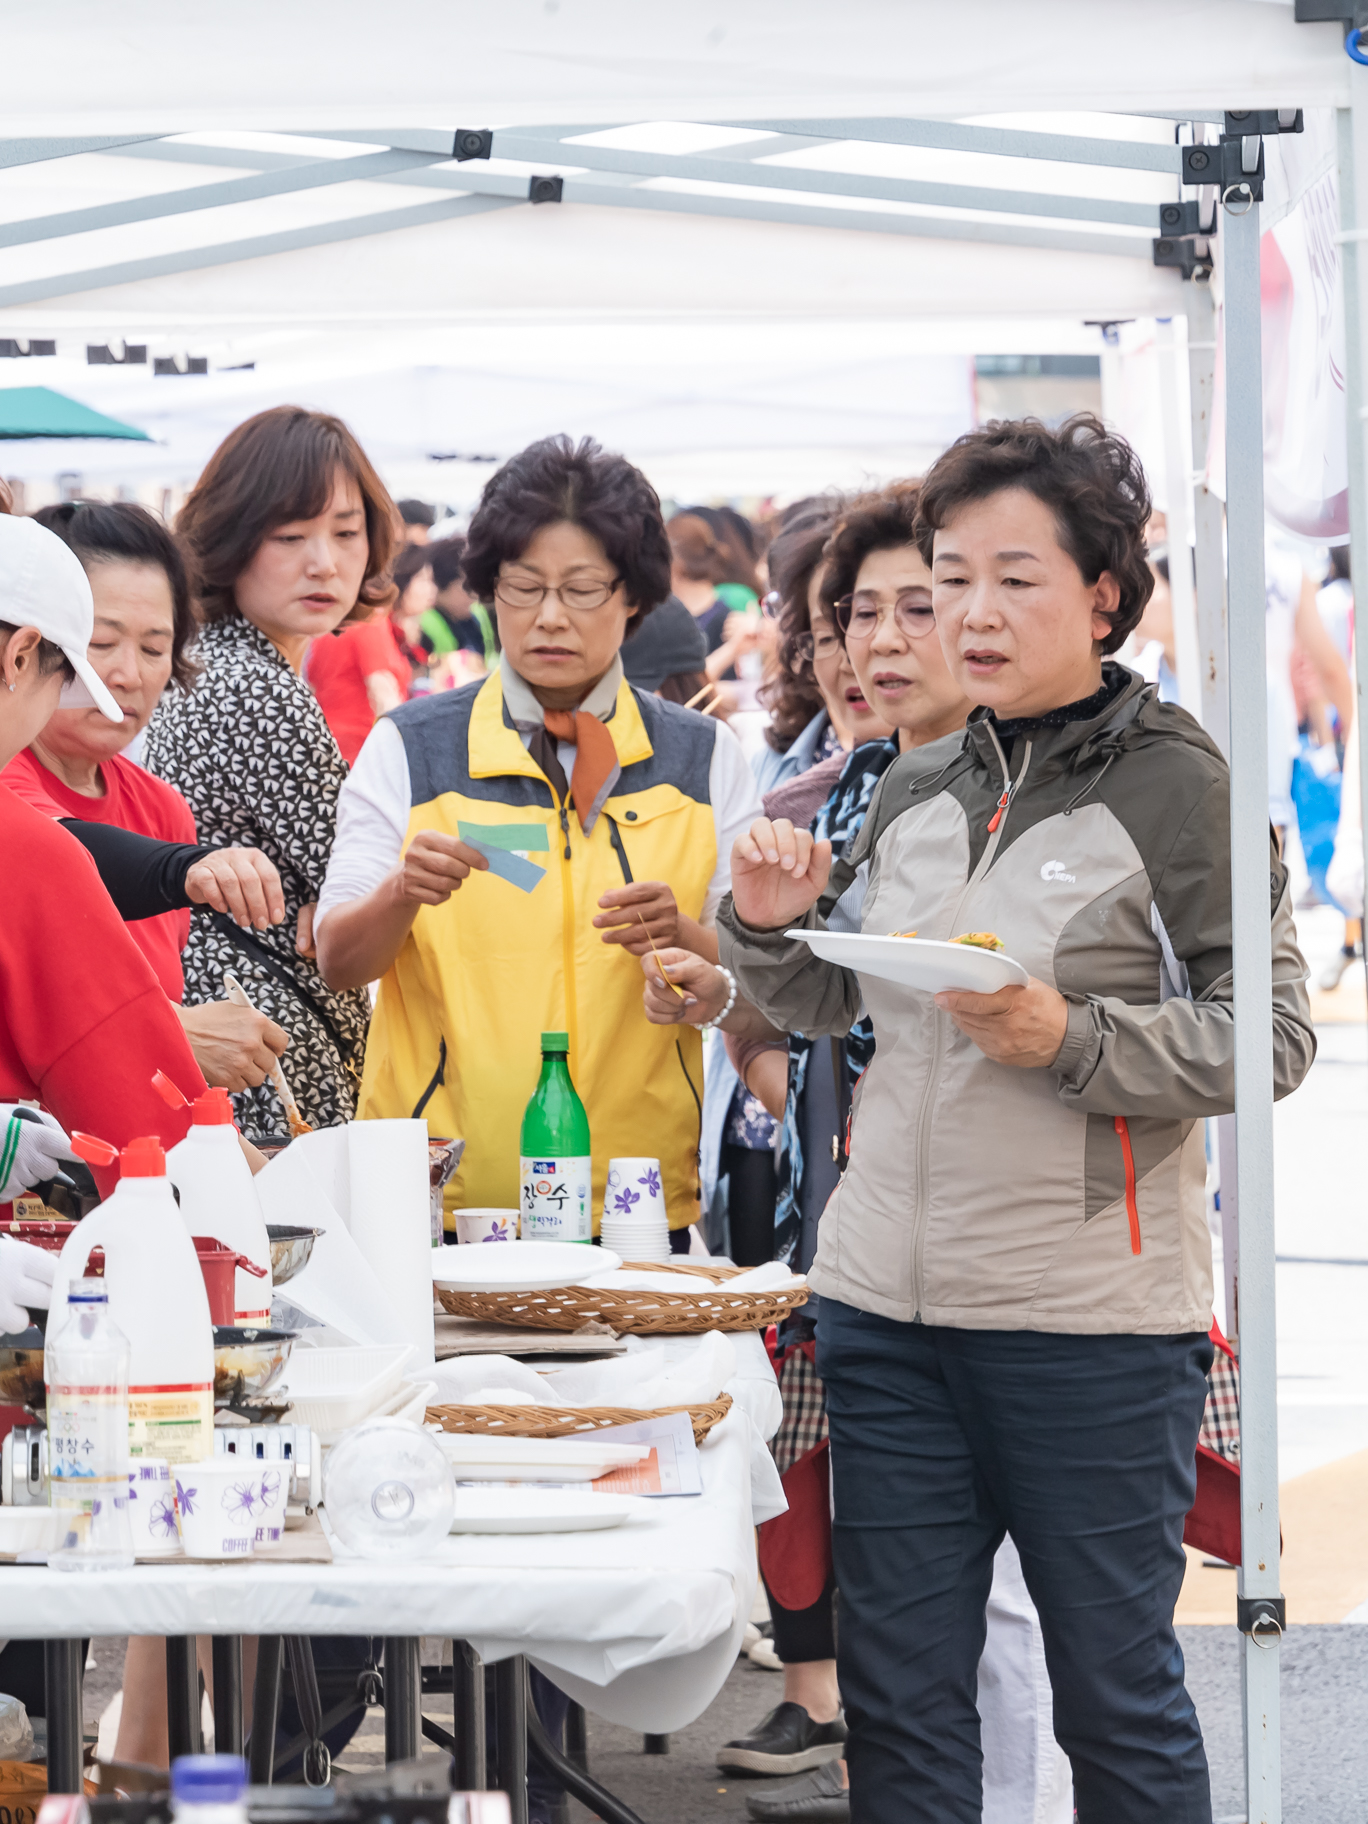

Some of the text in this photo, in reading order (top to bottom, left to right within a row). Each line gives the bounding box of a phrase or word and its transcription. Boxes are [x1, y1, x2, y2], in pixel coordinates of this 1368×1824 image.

[523, 1183, 570, 1210] 장수
[55, 1437, 95, 1455] 평창수
[222, 1538, 248, 1552] COFFEE
